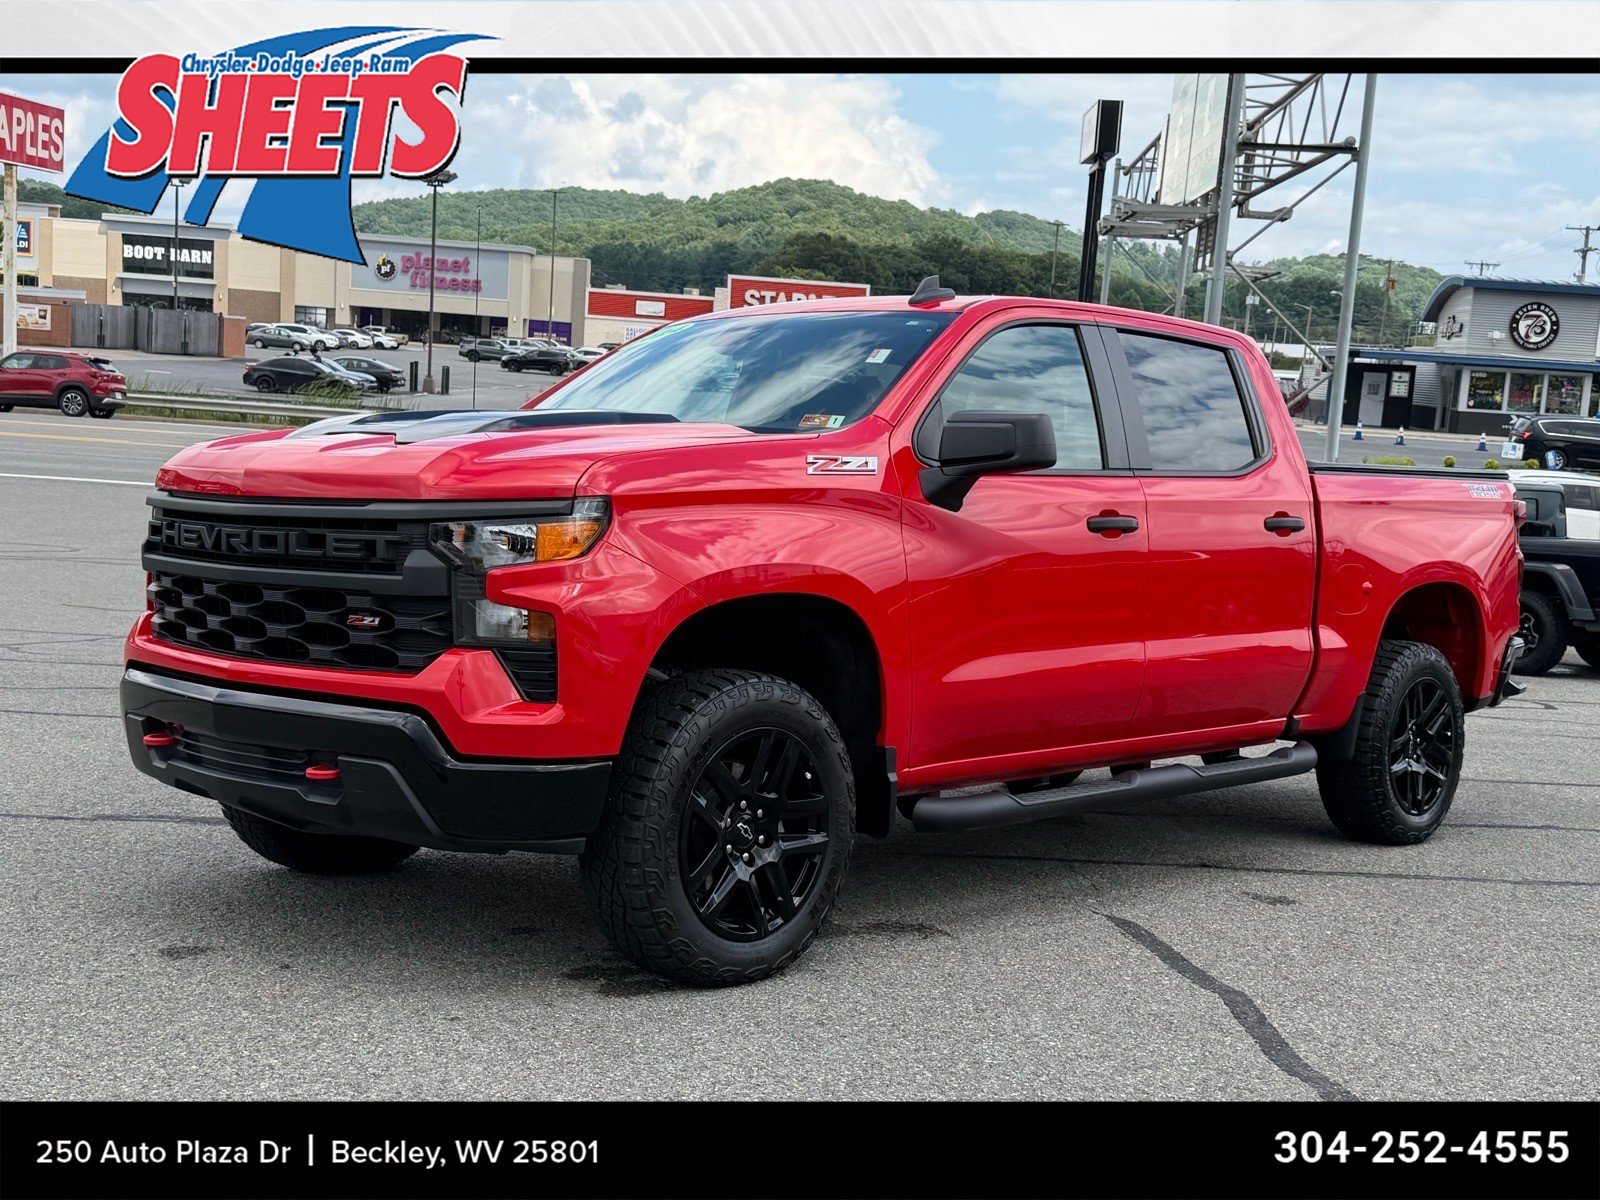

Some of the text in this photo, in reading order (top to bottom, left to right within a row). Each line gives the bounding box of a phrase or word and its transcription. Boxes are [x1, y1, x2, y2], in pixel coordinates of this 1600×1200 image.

[123, 244, 213, 264] BOOT BARN
[401, 251, 470, 274] planet
[149, 520, 405, 560] CHEVROLET
